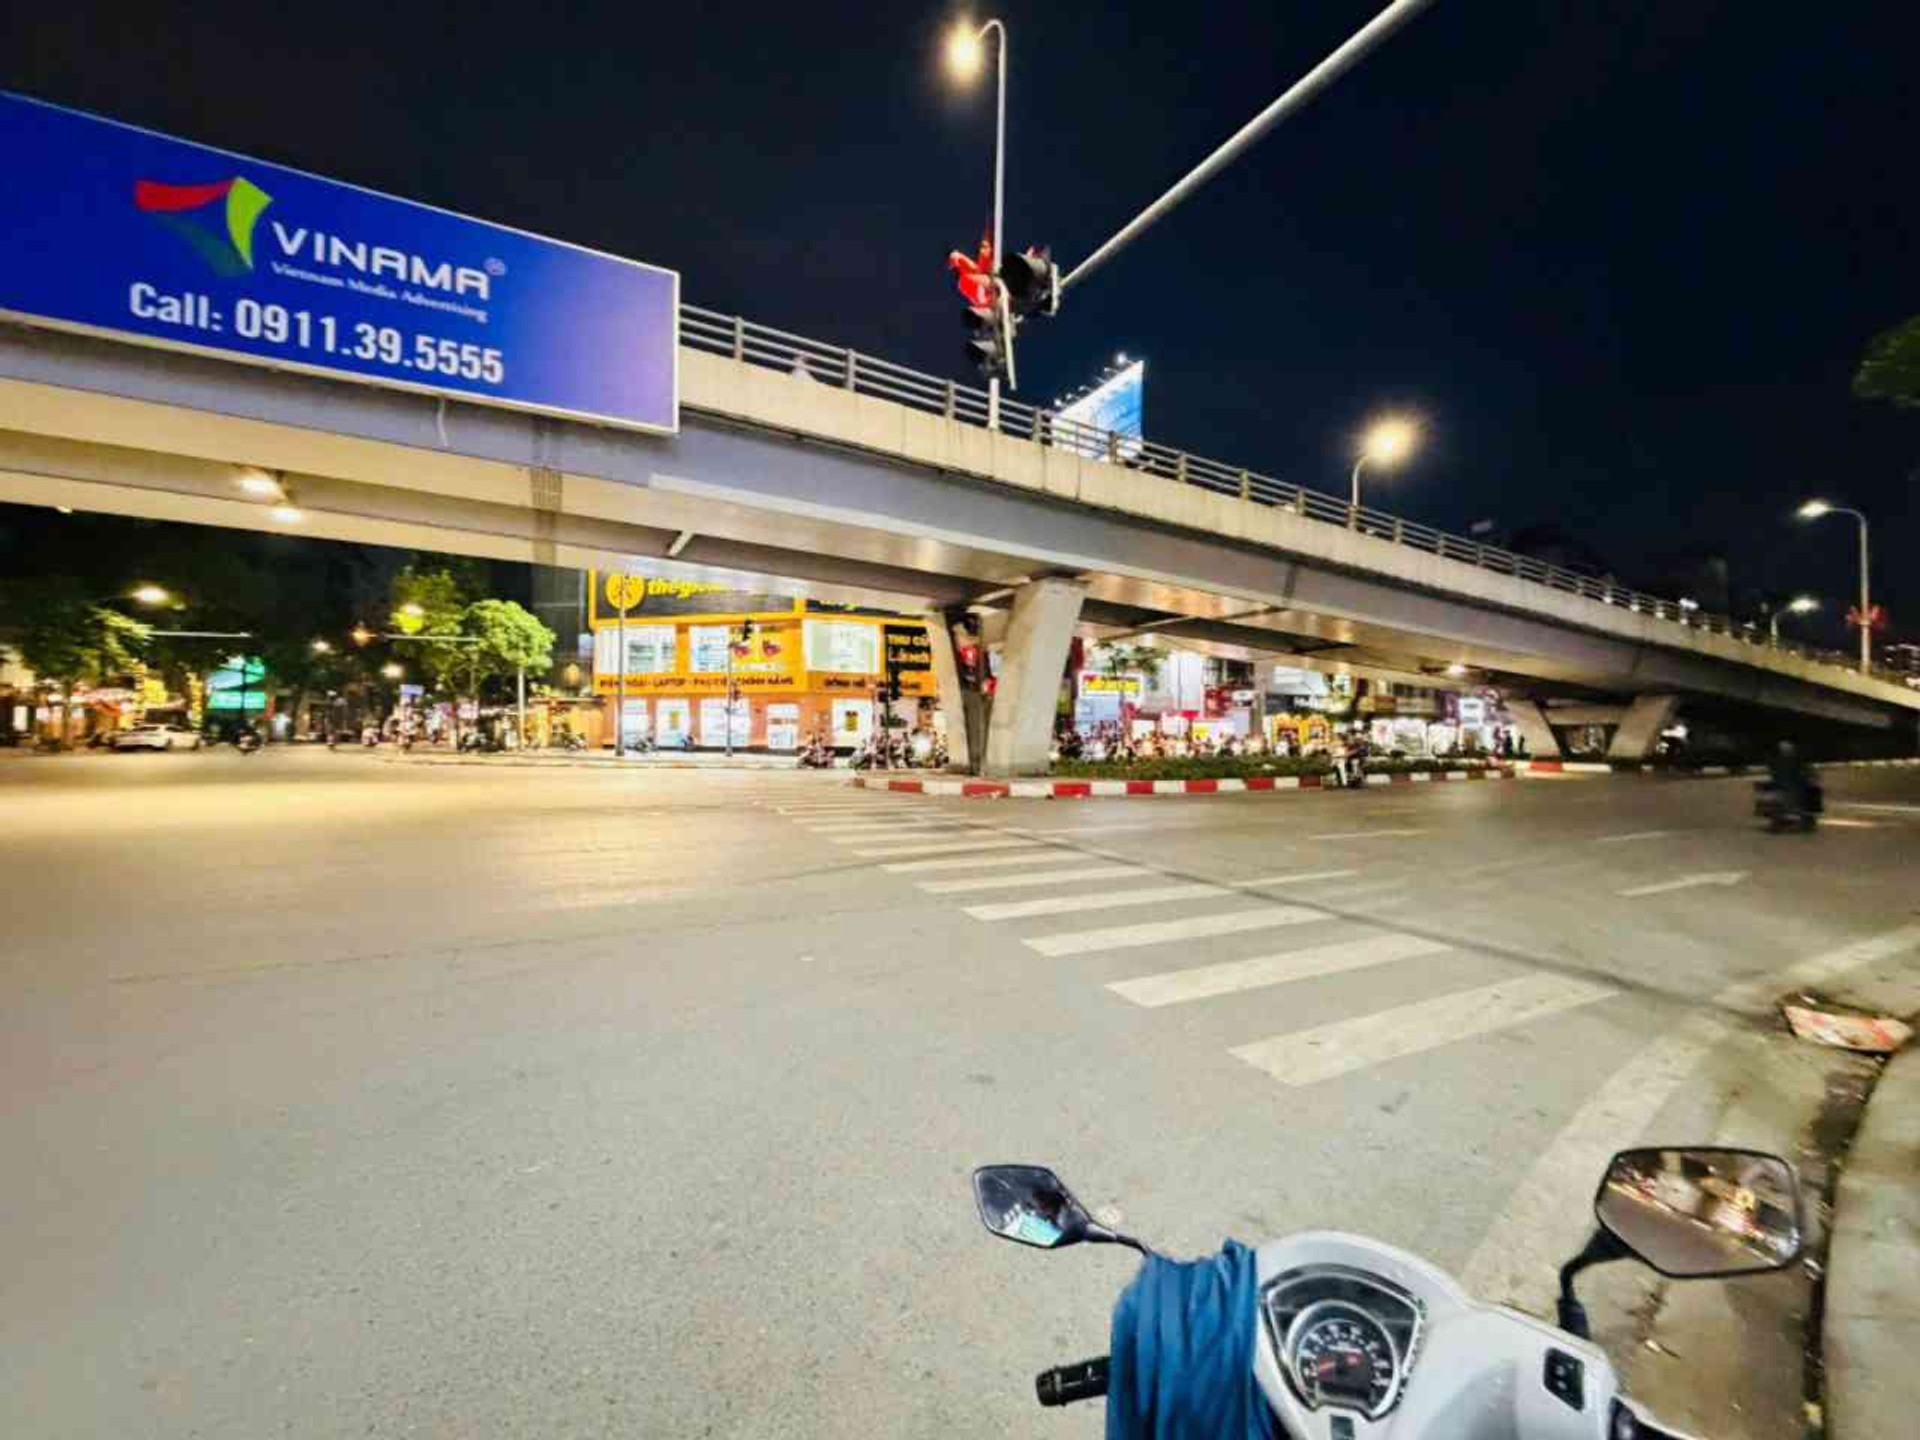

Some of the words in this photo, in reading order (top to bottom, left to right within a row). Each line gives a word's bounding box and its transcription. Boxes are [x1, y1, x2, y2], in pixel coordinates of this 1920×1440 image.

[272, 220, 491, 301] VINAMA
[129, 282, 223, 332] Call:
[234, 298, 504, 385] 0911.39.5555
